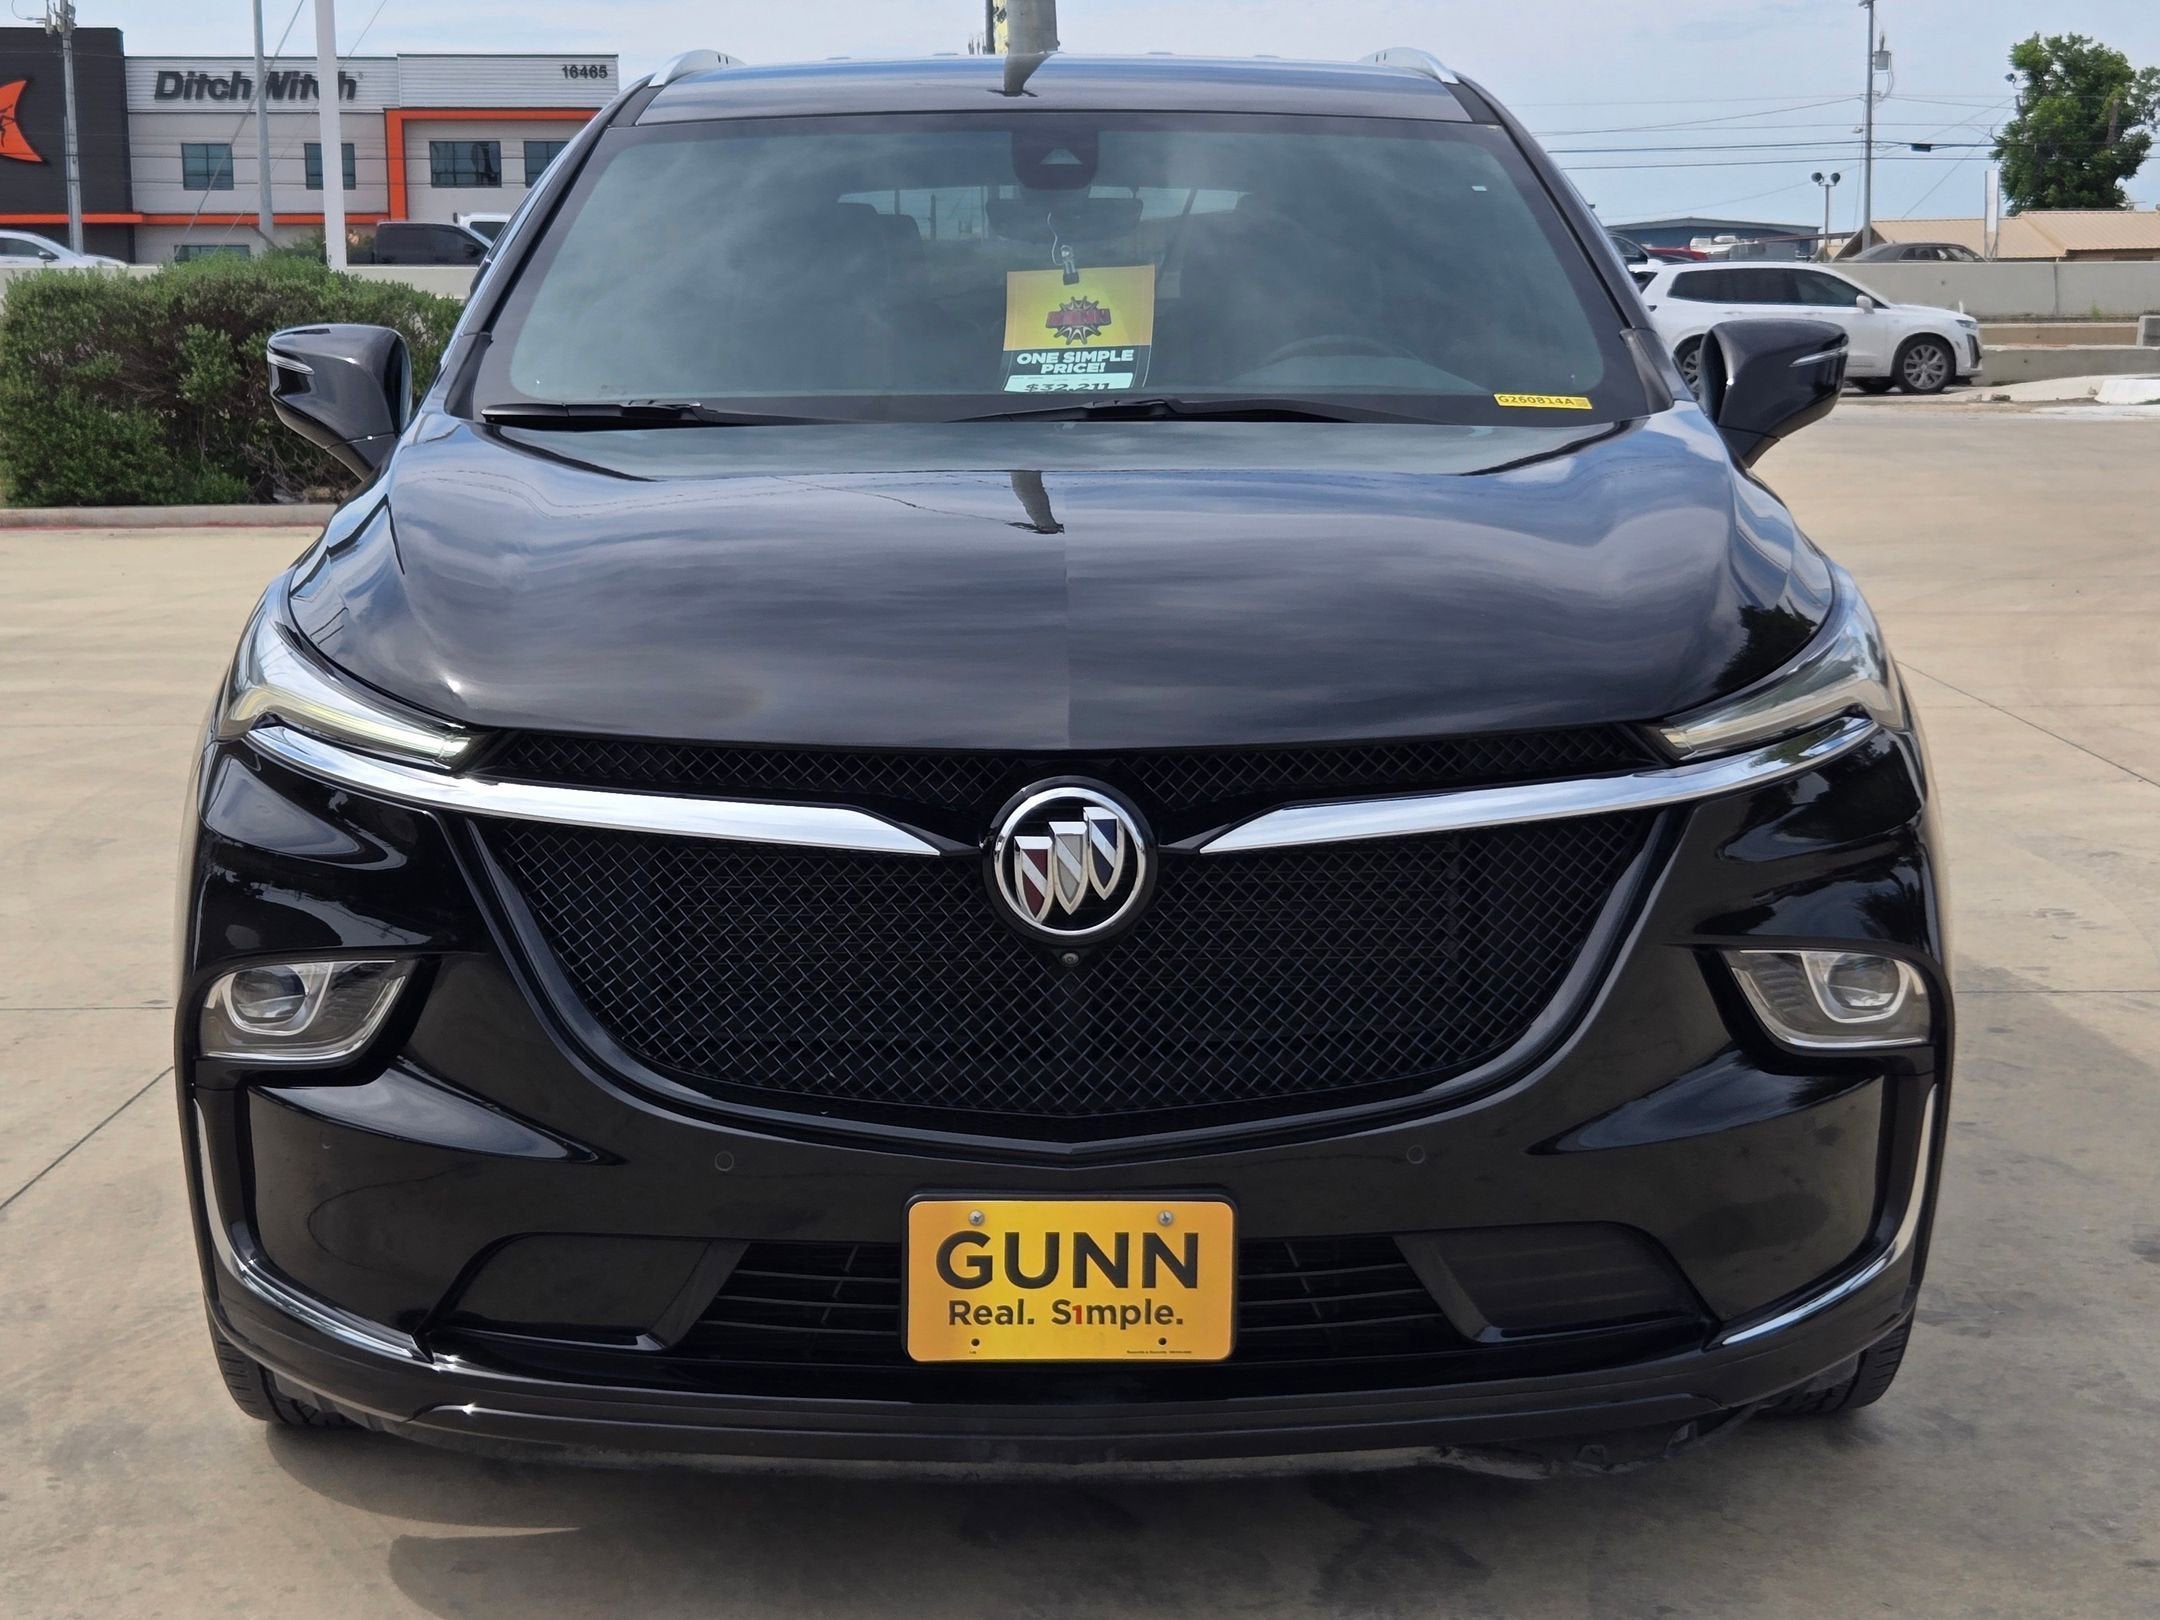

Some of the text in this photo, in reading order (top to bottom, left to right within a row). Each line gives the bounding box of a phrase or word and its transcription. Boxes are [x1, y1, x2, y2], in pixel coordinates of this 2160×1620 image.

[561, 64, 608, 79] 16465
[154, 70, 357, 100] Ditch With
[1016, 349, 1134, 364] ONE SIMPLE
[1040, 362, 1106, 373] PRICE!
[1498, 395, 1575, 405] G260814A
[936, 1230, 1199, 1290] GUNN
[949, 1298, 1035, 1326] Real.
